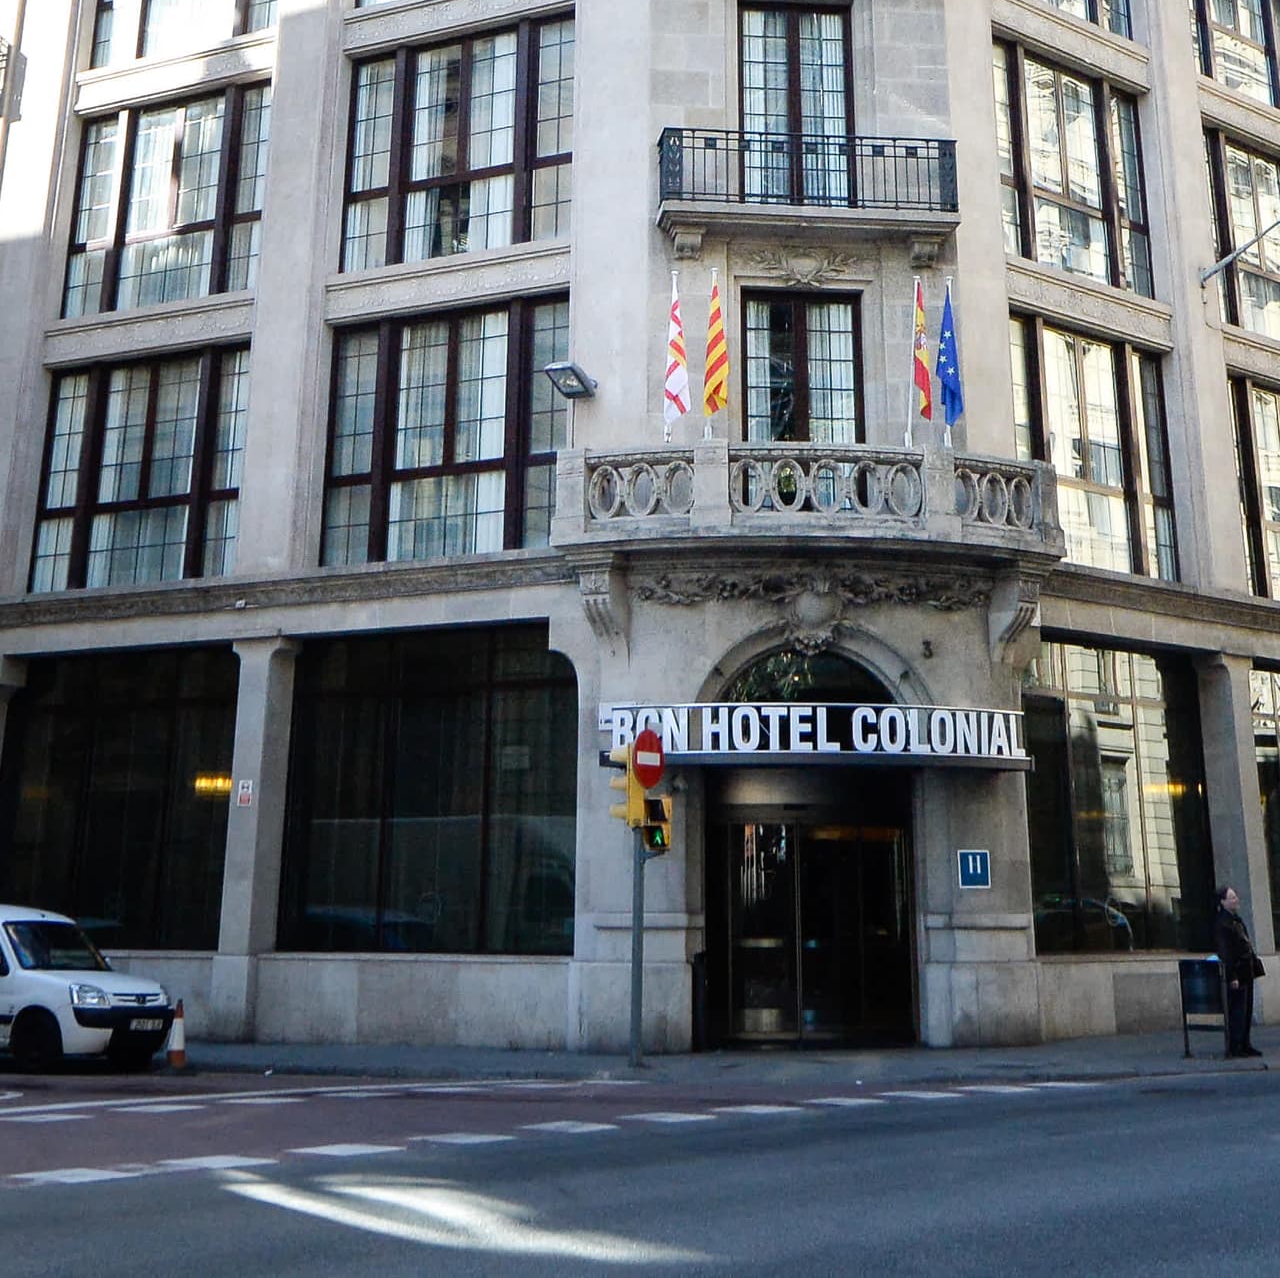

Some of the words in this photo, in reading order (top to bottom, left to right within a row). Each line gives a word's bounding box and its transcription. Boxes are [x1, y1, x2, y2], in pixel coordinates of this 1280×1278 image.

[922, 639, 933, 659] 3
[702, 706, 840, 753] HOTEL
[852, 706, 1026, 758] COLONIAL
